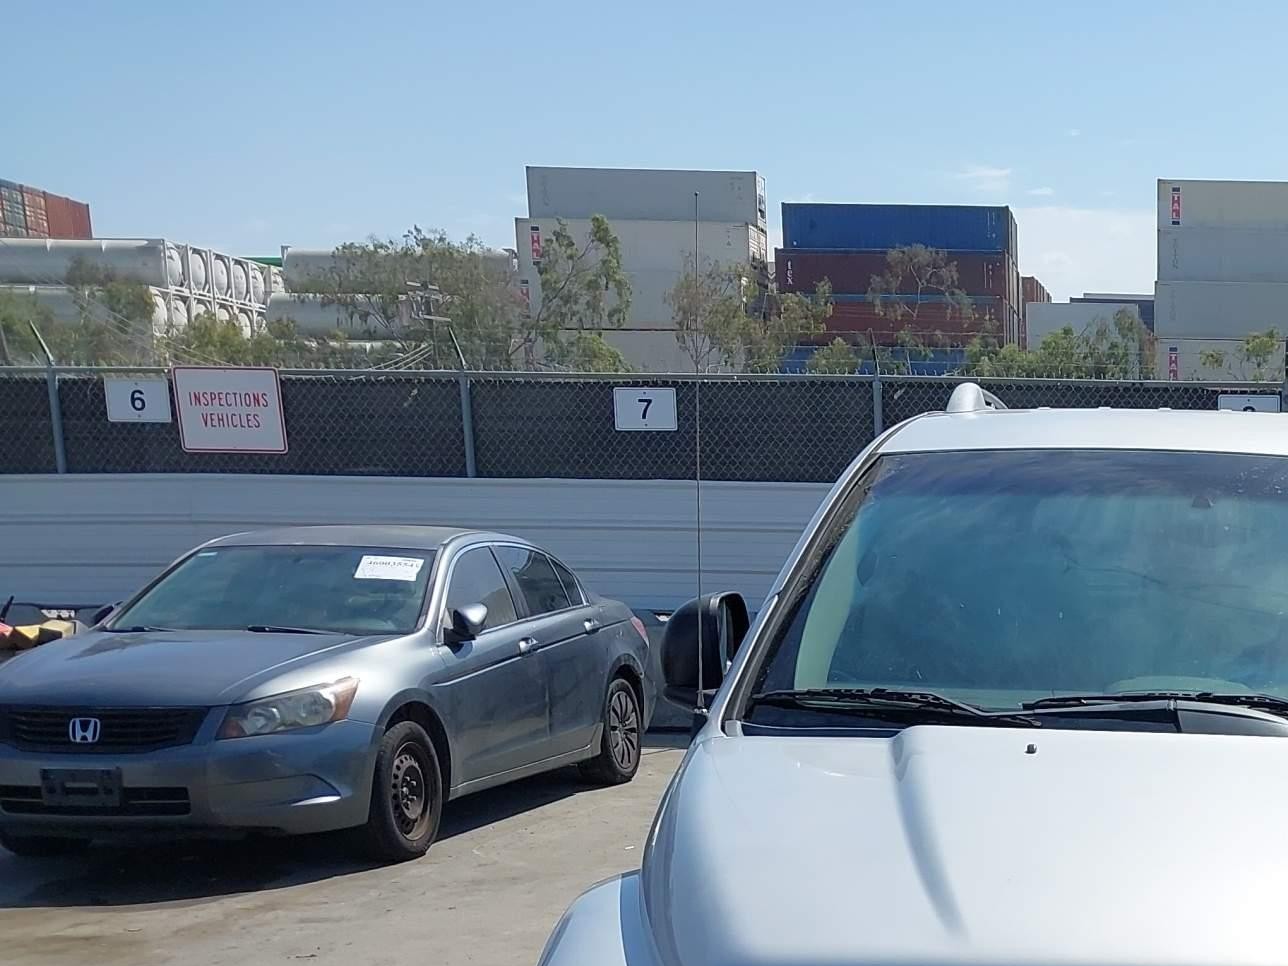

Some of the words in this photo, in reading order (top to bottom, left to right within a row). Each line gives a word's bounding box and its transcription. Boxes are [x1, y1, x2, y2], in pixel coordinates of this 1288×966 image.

[1172, 192, 1180, 220] TAL
[130, 389, 146, 411] 6
[188, 391, 269, 408] INSPECTIONS
[637, 398, 653, 419] 7
[201, 412, 261, 428] VEHICLES
